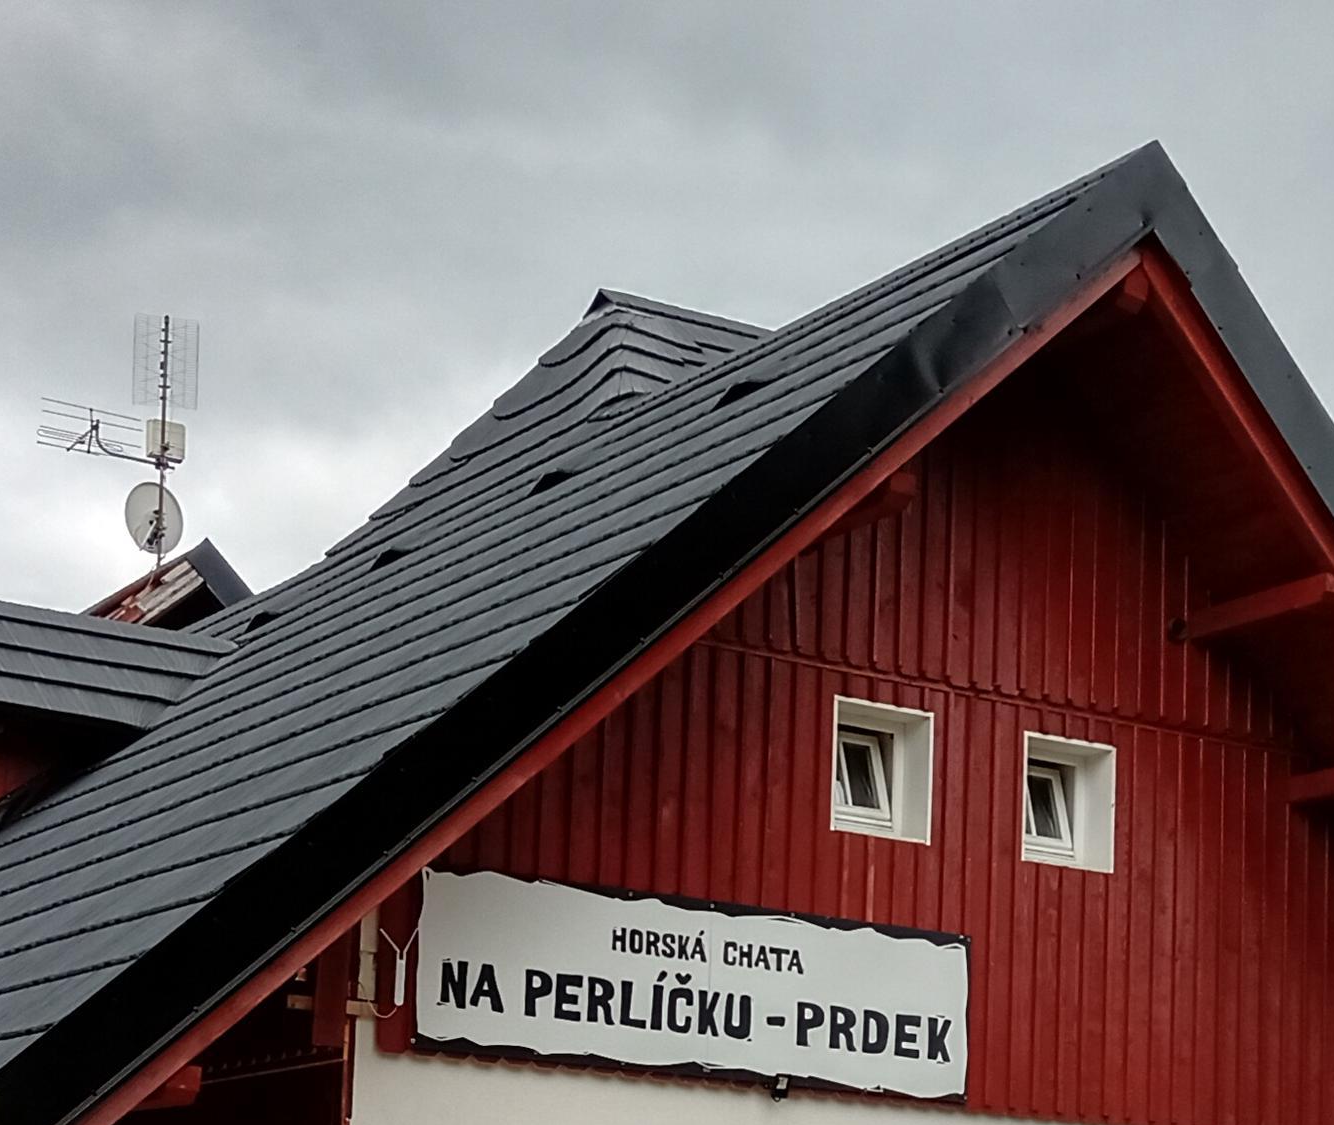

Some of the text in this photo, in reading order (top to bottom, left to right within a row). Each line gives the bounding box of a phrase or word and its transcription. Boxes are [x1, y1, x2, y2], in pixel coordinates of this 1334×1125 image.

[611, 926, 805, 975] HORSKÁ CHATA
[440, 960, 504, 1014] NA
[524, 968, 753, 1041] PERLÍČKU
[797, 1001, 952, 1063] PRDEK
